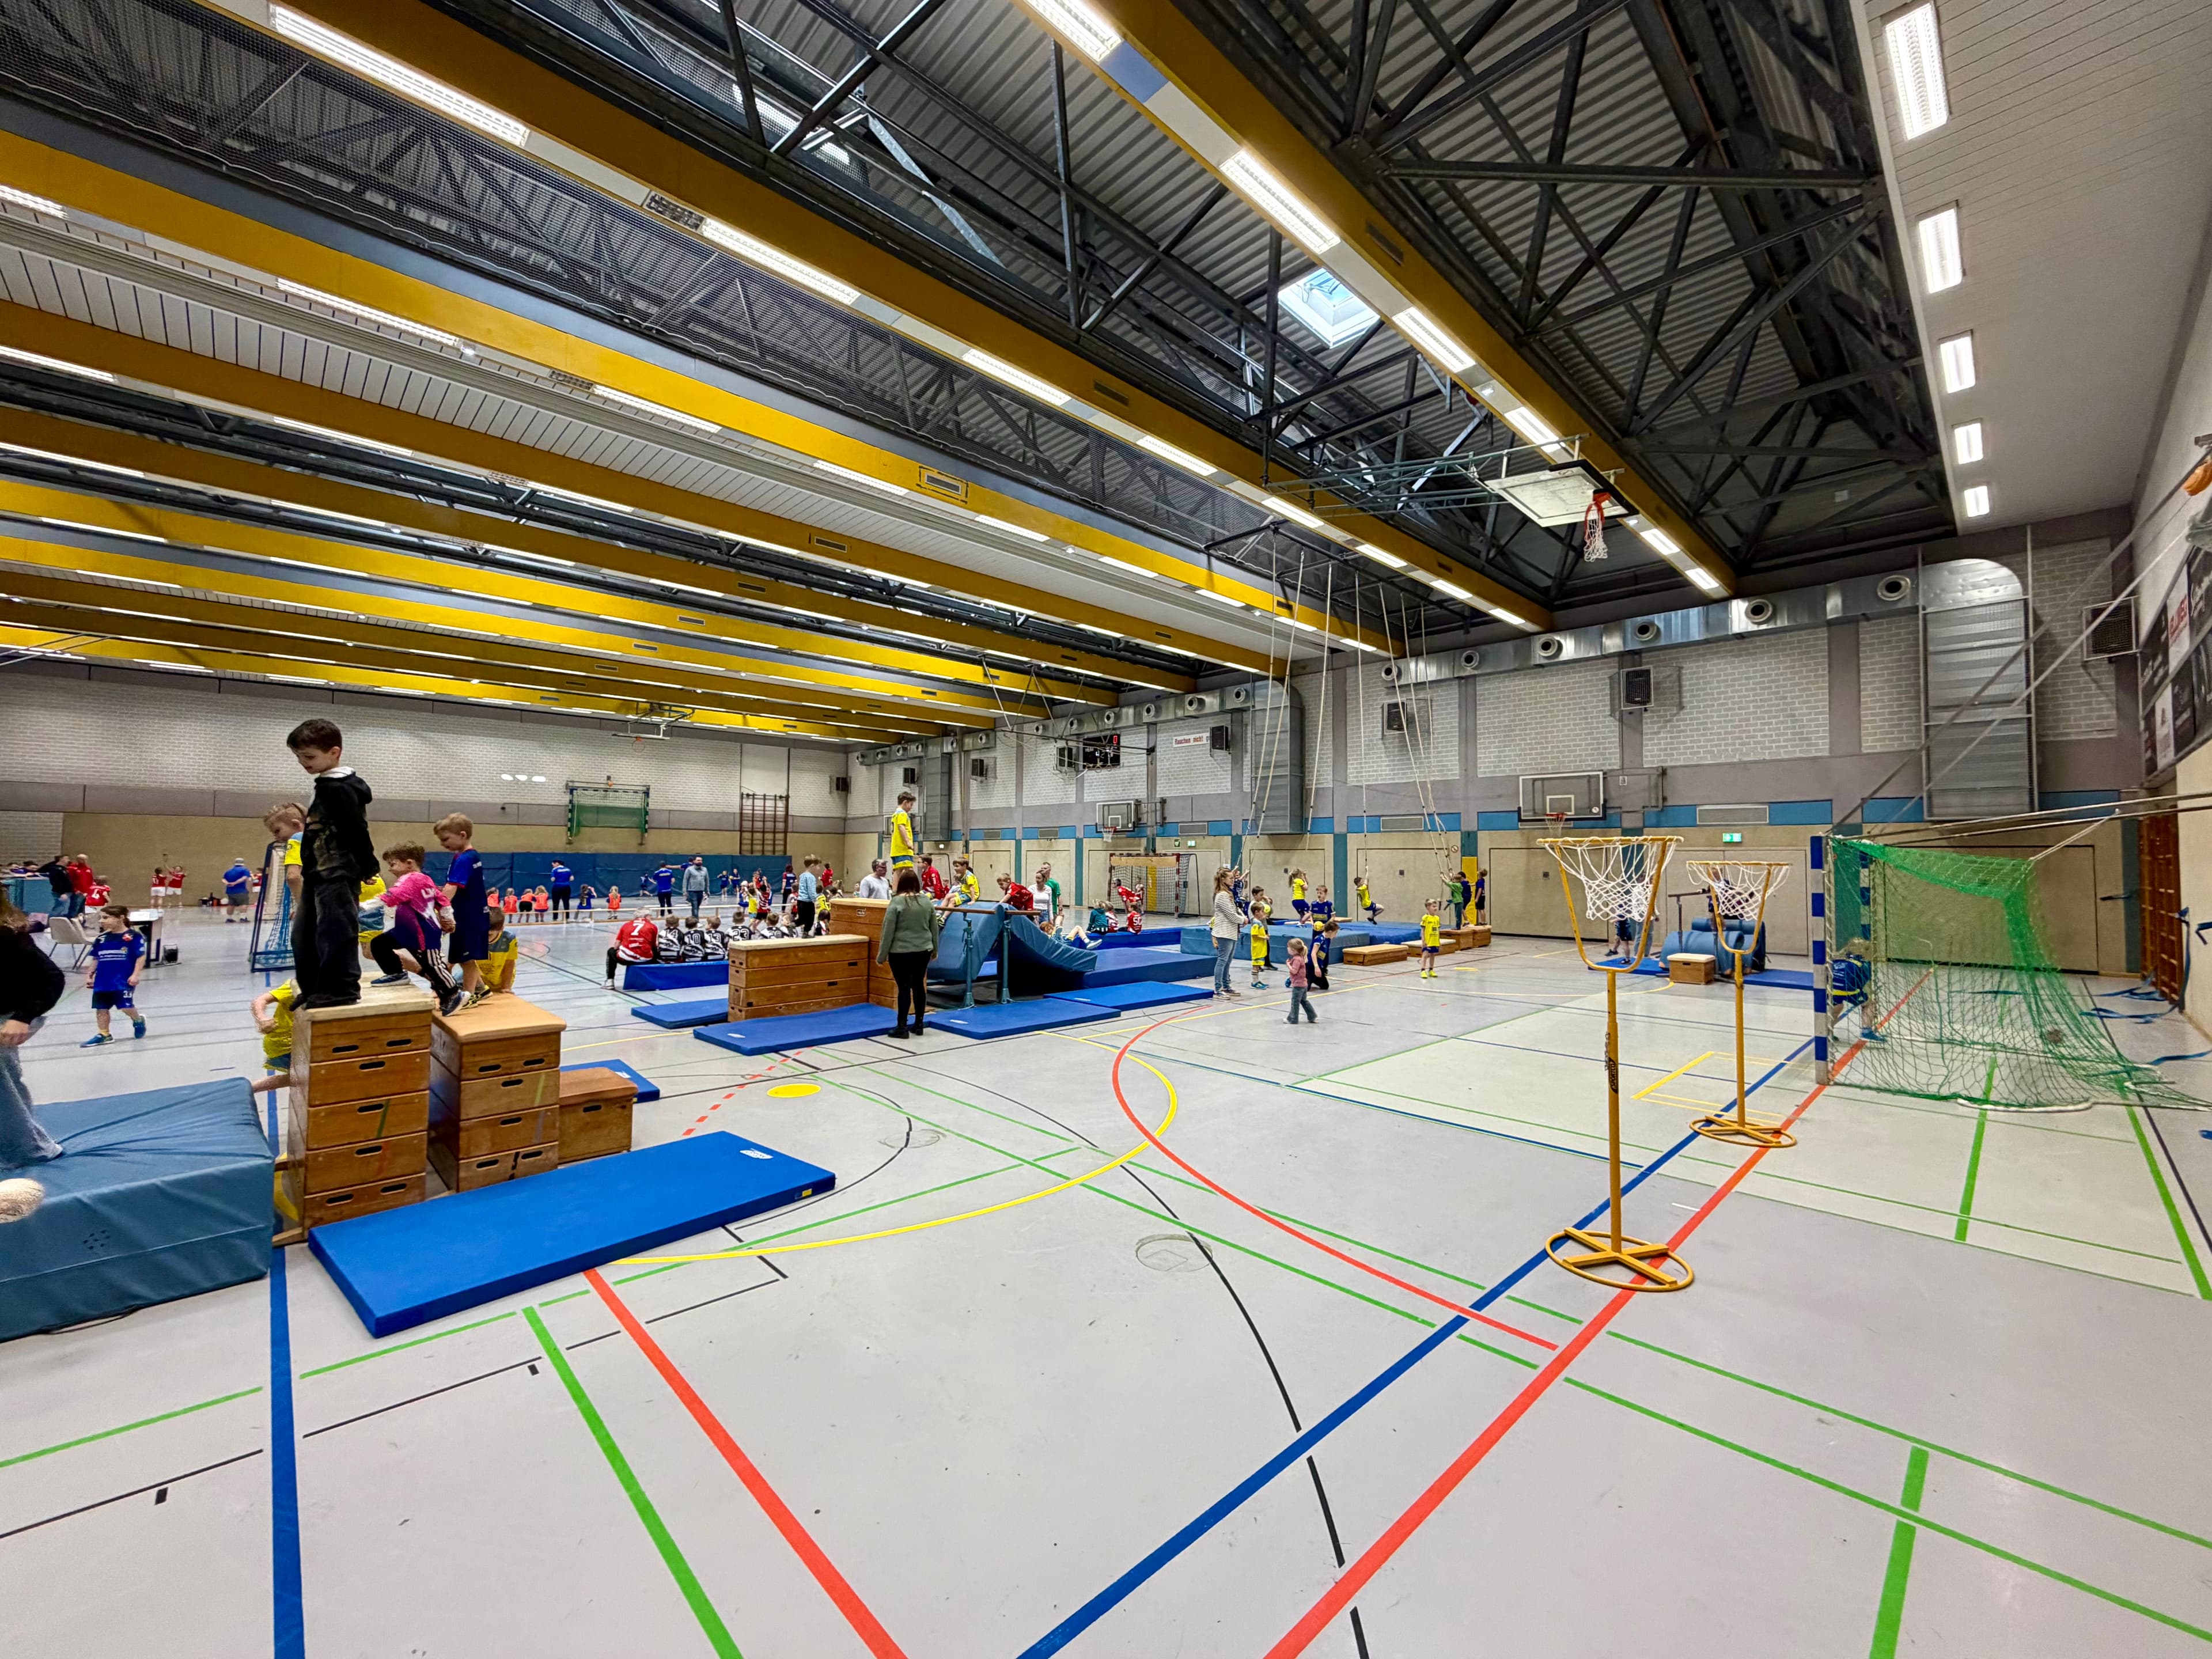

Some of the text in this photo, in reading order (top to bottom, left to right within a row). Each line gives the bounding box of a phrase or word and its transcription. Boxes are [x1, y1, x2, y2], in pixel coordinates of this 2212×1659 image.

[631, 923, 644, 935] 7
[663, 929, 678, 938] 14
[732, 927, 749, 941] 23
[686, 933, 701, 945] 10
[708, 933, 721, 943] 13
